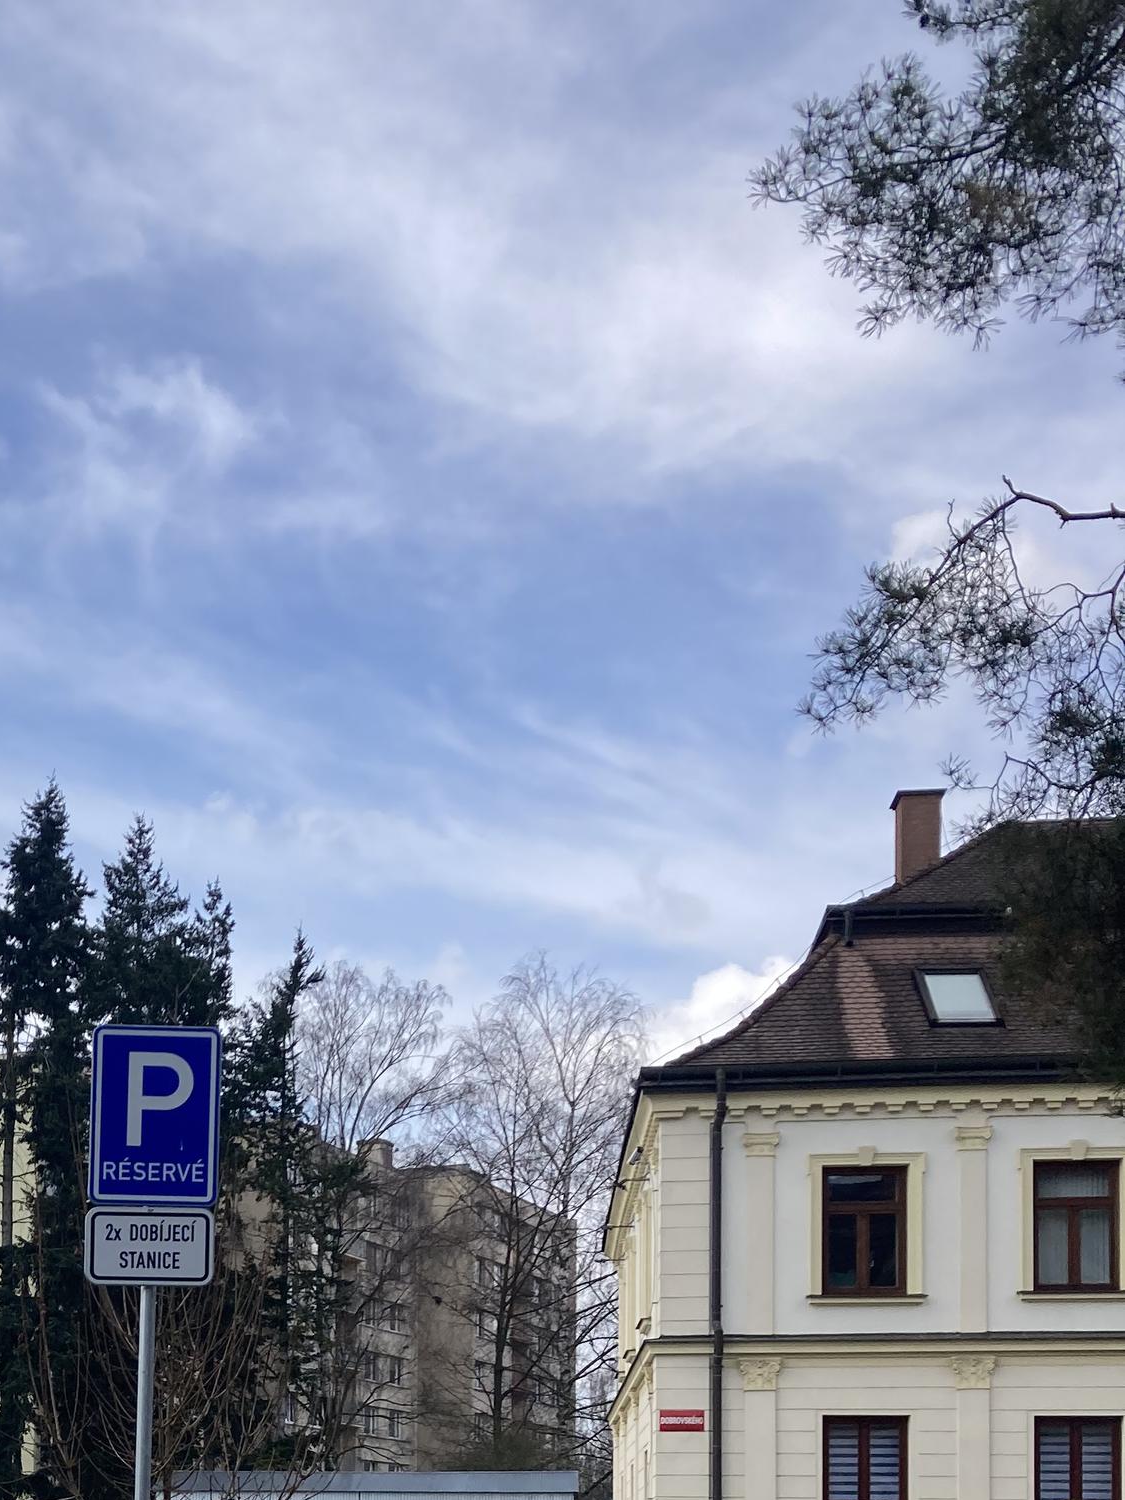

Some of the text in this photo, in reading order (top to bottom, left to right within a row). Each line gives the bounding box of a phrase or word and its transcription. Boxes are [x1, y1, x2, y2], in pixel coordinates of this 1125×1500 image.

[126, 1051, 194, 1147] P
[102, 1157, 205, 1183] RÉSERVÉ
[105, 1219, 197, 1243] 2x DOBÍJECÍ
[119, 1251, 181, 1270] STANICE
